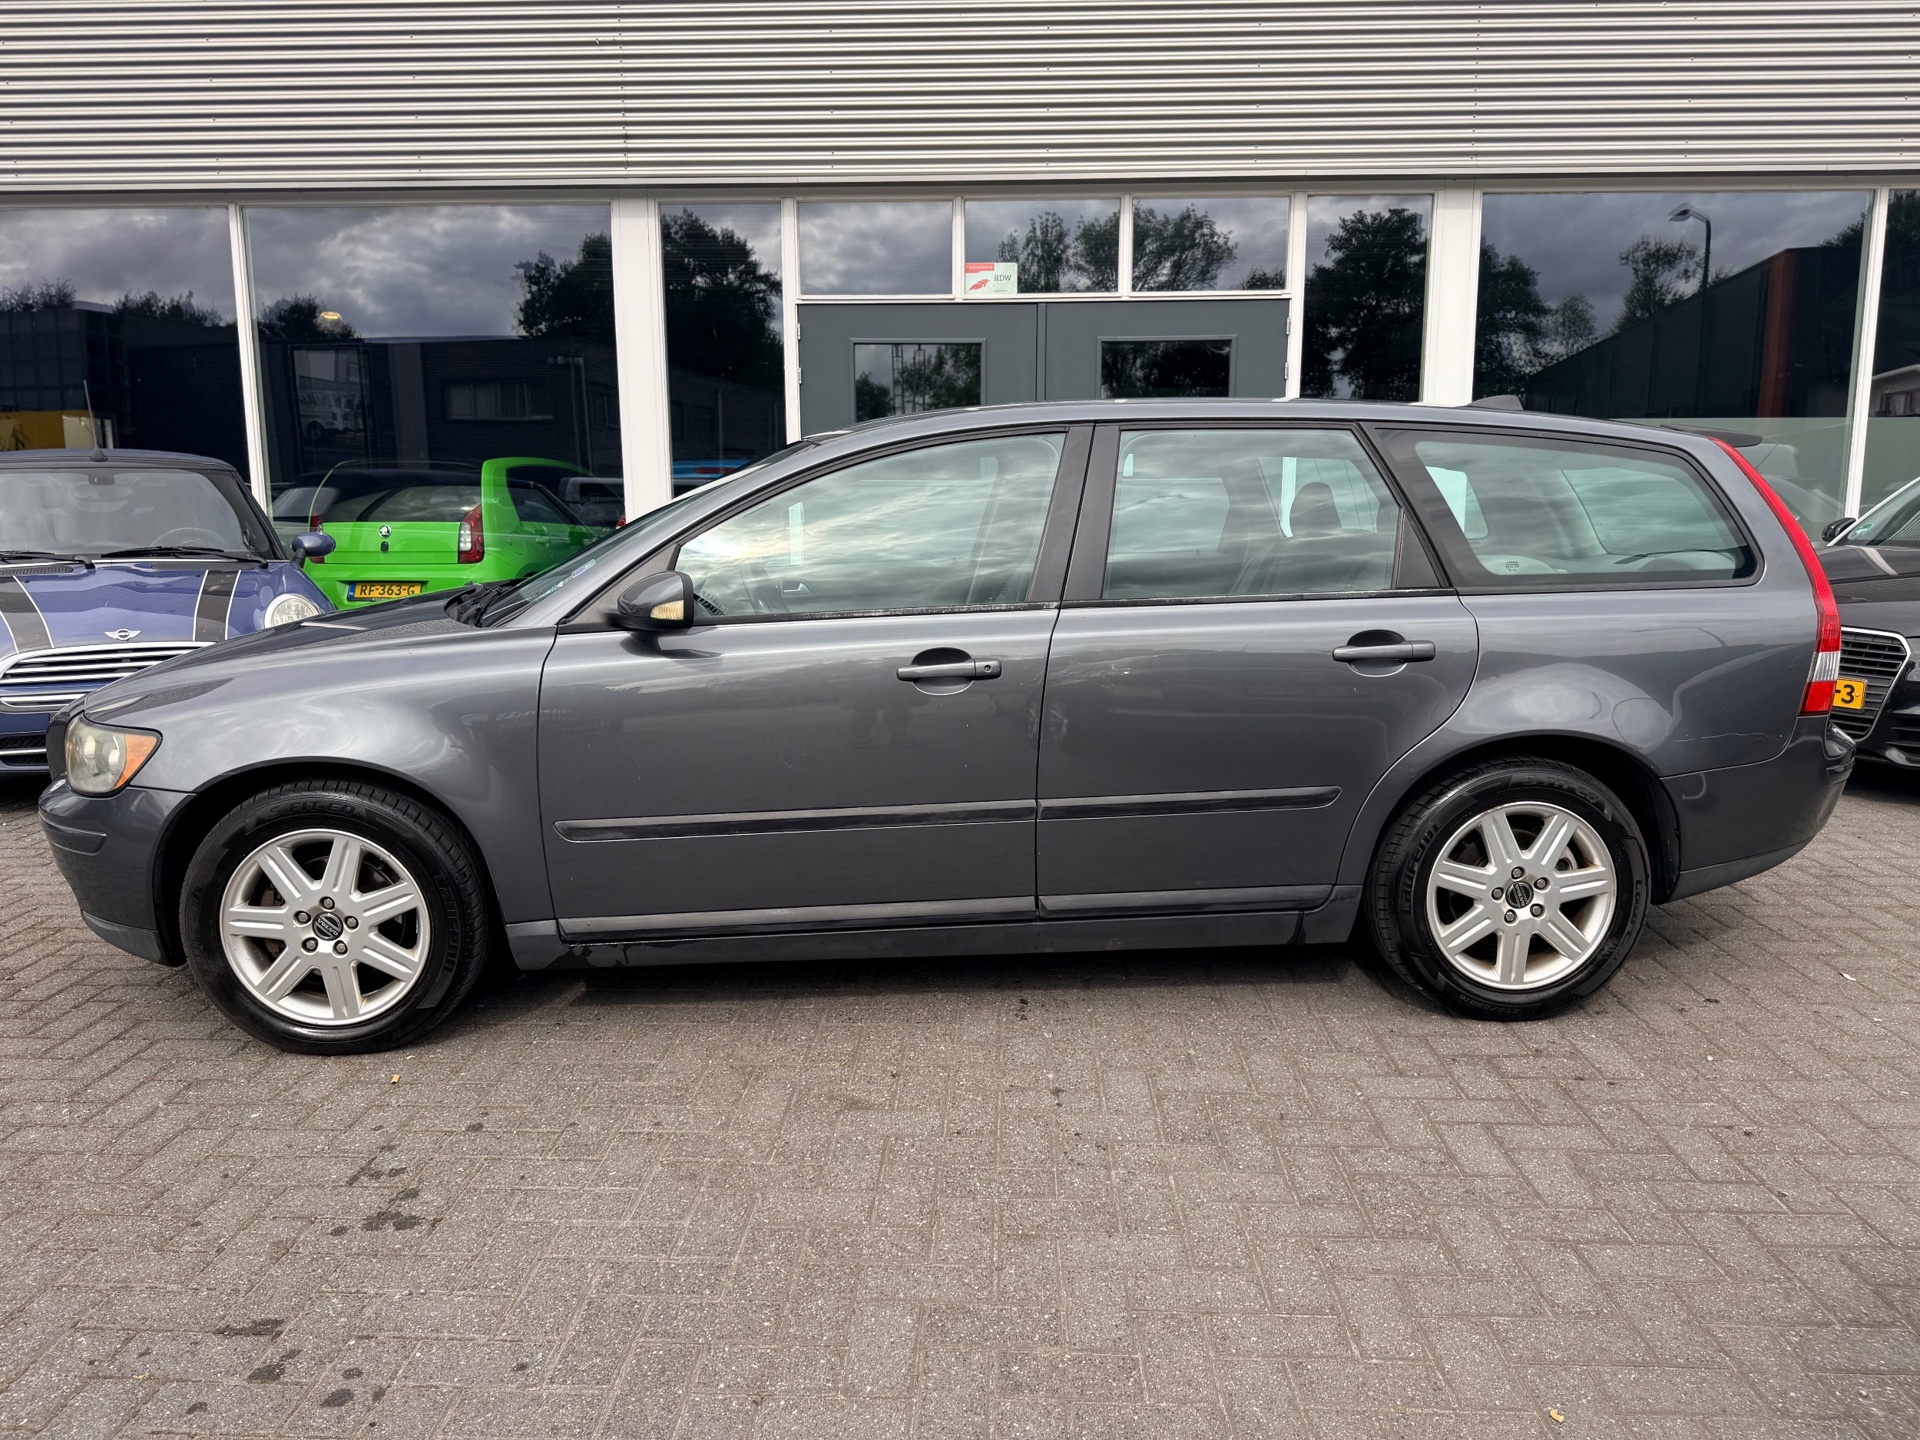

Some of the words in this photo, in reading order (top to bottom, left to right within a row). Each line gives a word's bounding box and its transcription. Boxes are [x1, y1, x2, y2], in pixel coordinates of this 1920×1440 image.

[360, 585, 415, 596] RF-363-G
[1514, 883, 1526, 907] VOLVO
[317, 917, 339, 936] VOLVO
